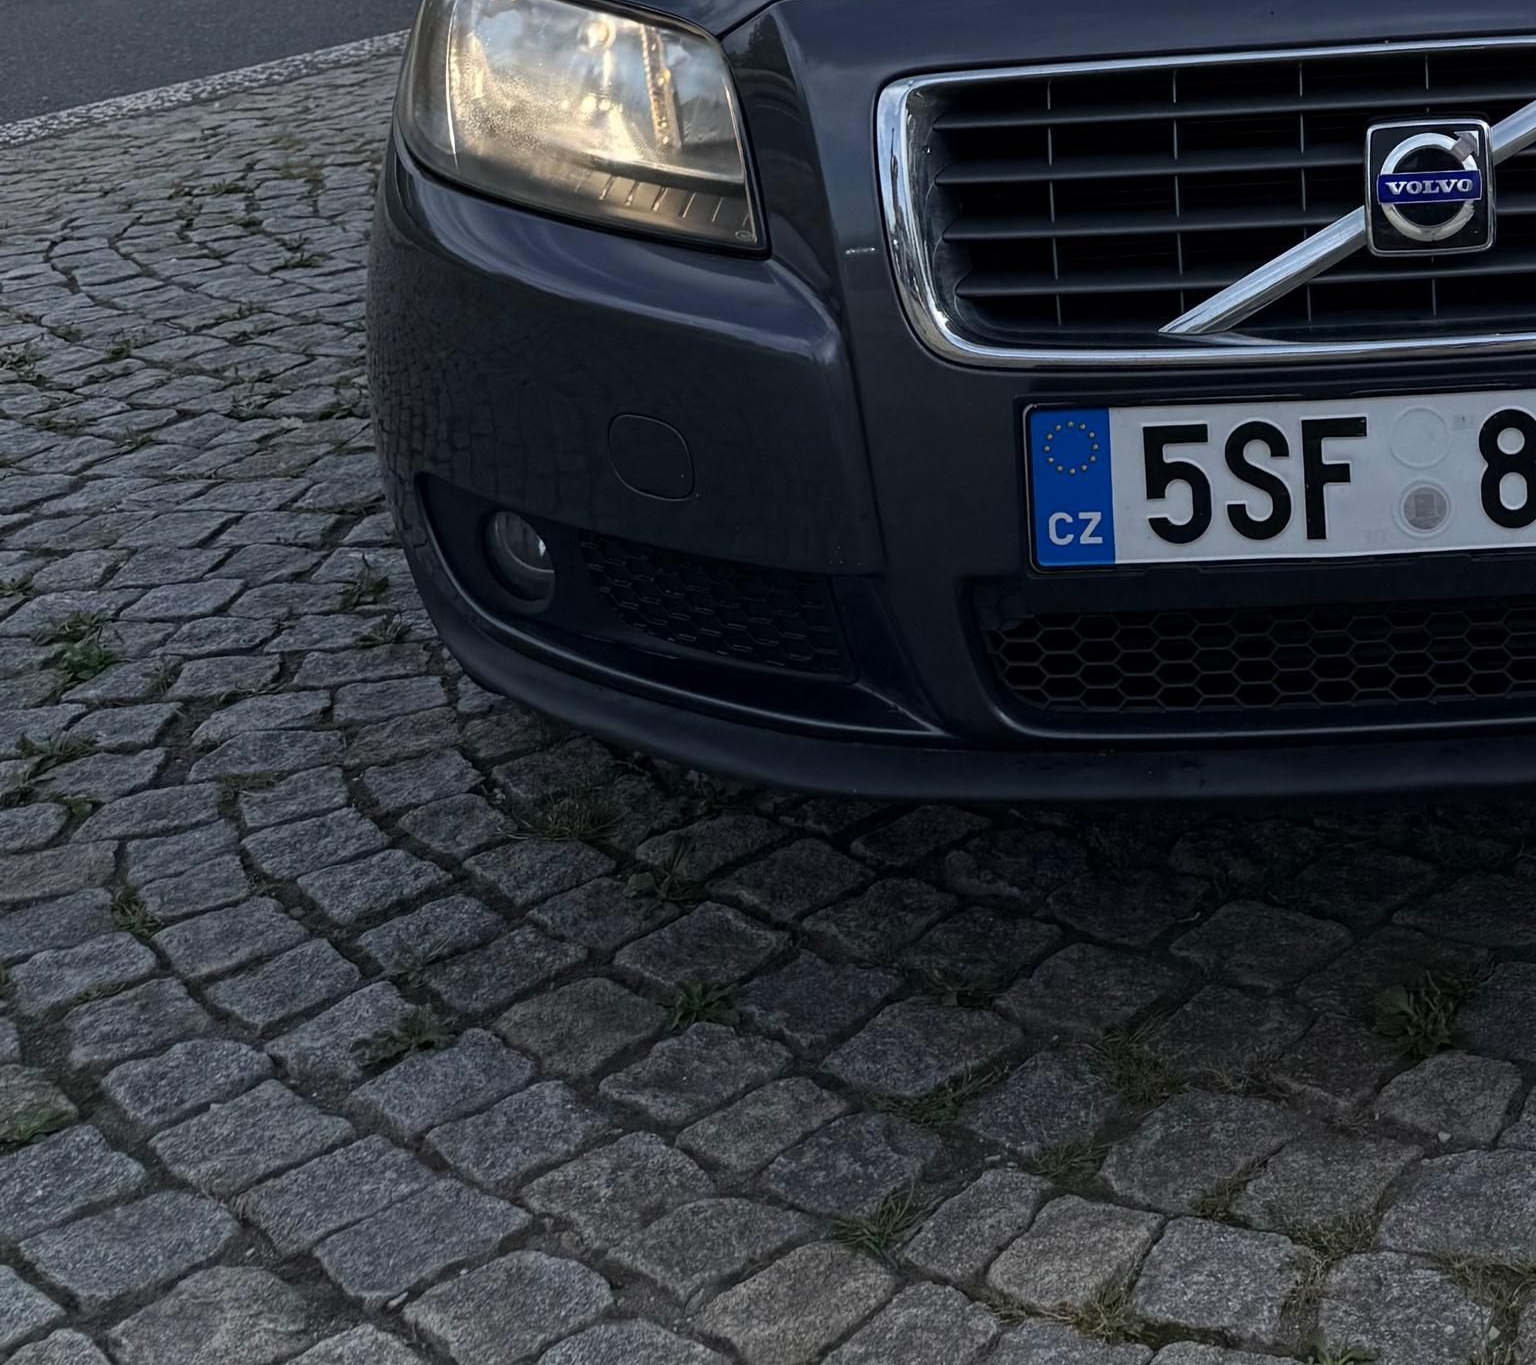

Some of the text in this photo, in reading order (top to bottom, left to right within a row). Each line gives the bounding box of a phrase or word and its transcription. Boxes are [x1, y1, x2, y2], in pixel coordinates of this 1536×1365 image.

[1385, 178, 1473, 195] VOLVO
[1142, 416, 1368, 545] 5SF
[1047, 511, 1104, 546] CZ
